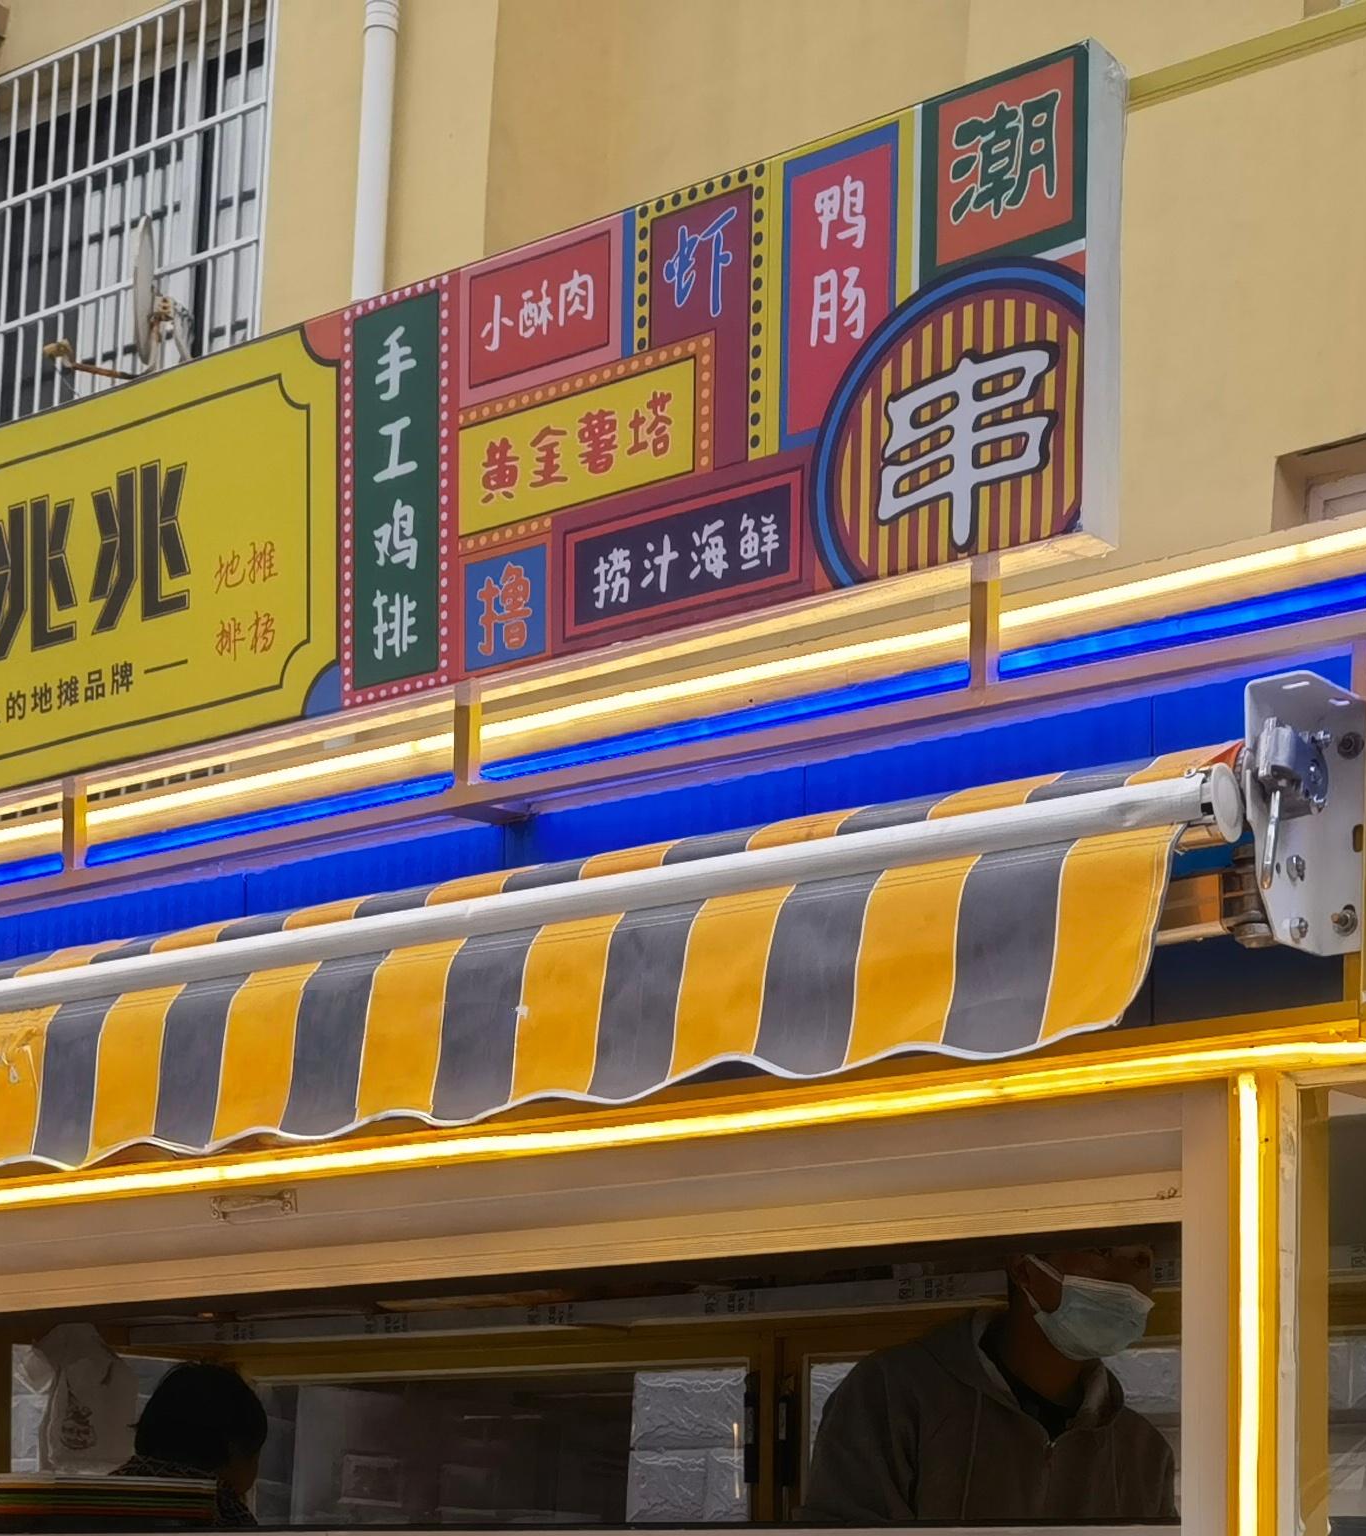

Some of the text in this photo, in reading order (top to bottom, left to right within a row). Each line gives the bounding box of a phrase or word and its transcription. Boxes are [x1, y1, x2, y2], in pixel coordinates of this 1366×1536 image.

[950, 89, 1060, 226] 潮
[481, 269, 595, 352] 小酥肉
[663, 206, 738, 319] 虾
[810, 175, 867, 347] 鸭肠
[373, 325, 418, 661] 手工鸡排
[479, 391, 673, 505] 黄金薯塔
[875, 341, 1060, 552] 串
[477, 562, 532, 656] 撸
[593, 513, 780, 609] 捞汁海鲜
